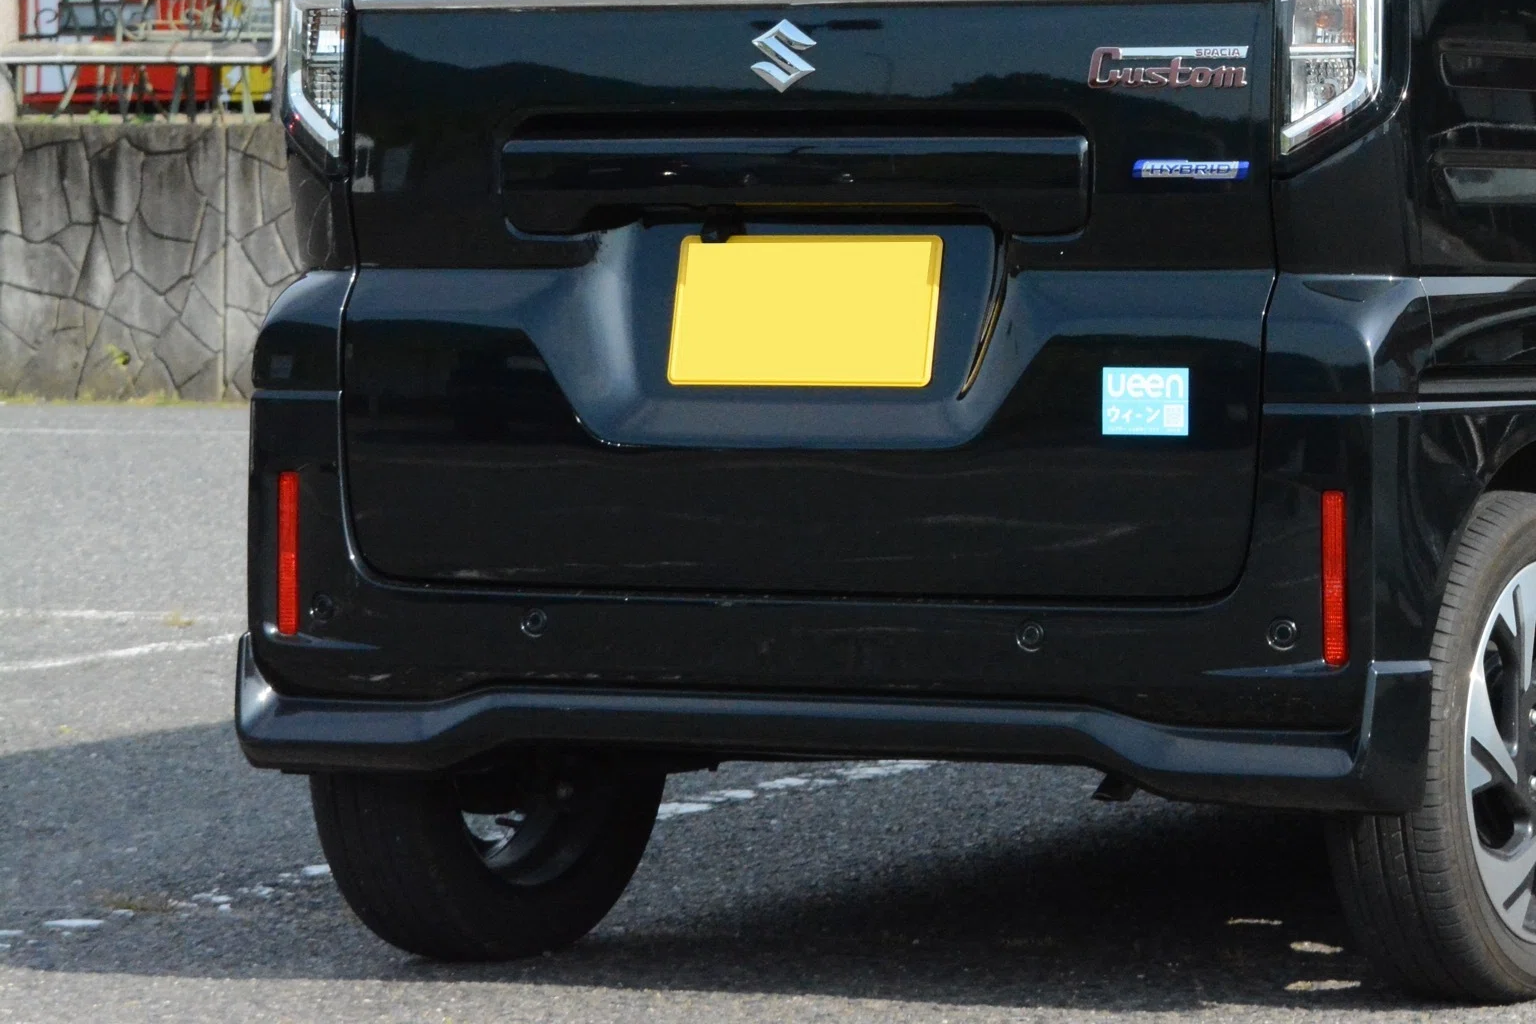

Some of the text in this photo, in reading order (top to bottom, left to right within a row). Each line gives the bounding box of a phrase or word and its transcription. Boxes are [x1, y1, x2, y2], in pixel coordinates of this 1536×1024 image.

[1195, 47, 1241, 58] SPACIA
[1087, 46, 1248, 88] Custom
[1149, 163, 1231, 175] HYBRID
[1107, 373, 1184, 398] ueen
[1107, 406, 1161, 423] ウィーン
